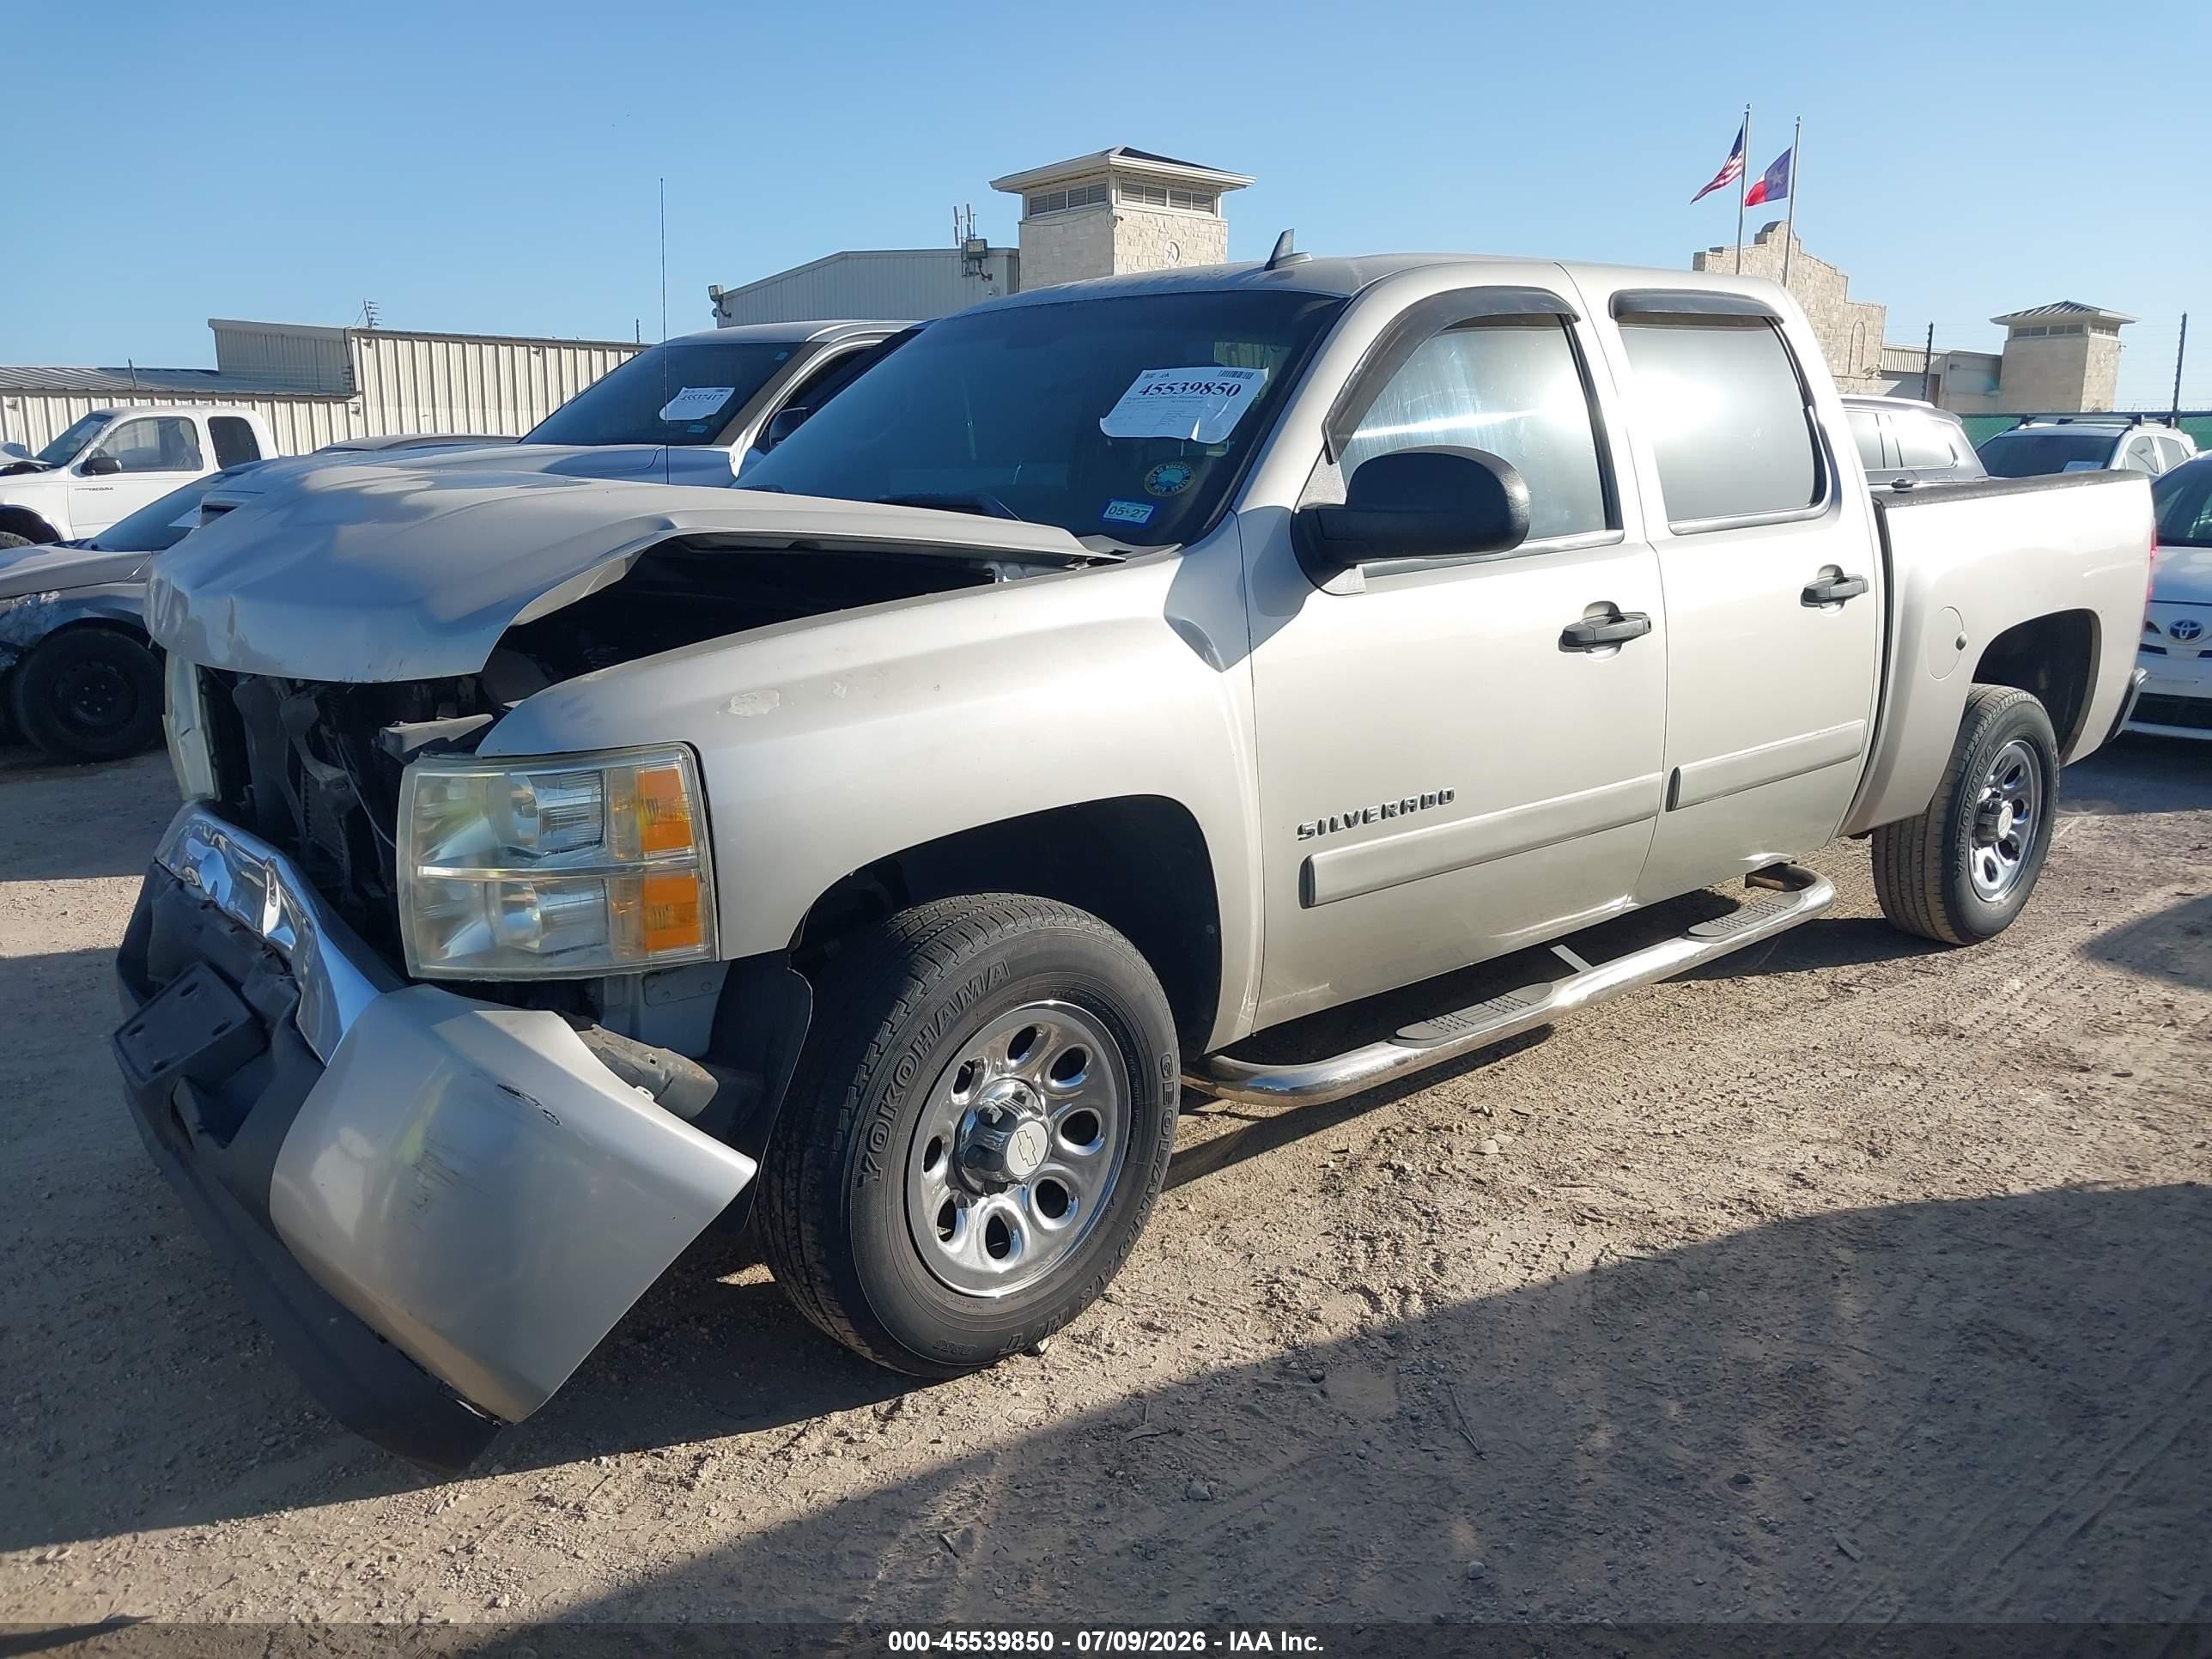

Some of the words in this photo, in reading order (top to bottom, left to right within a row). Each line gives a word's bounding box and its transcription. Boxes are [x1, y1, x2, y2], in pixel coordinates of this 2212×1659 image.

[1139, 381, 1242, 398] 45539850
[1109, 506, 1126, 516] 05
[1129, 508, 1149, 519] 27
[1296, 787, 1455, 841] SILVERADO
[857, 959, 1011, 1188] YOKOHAMA
